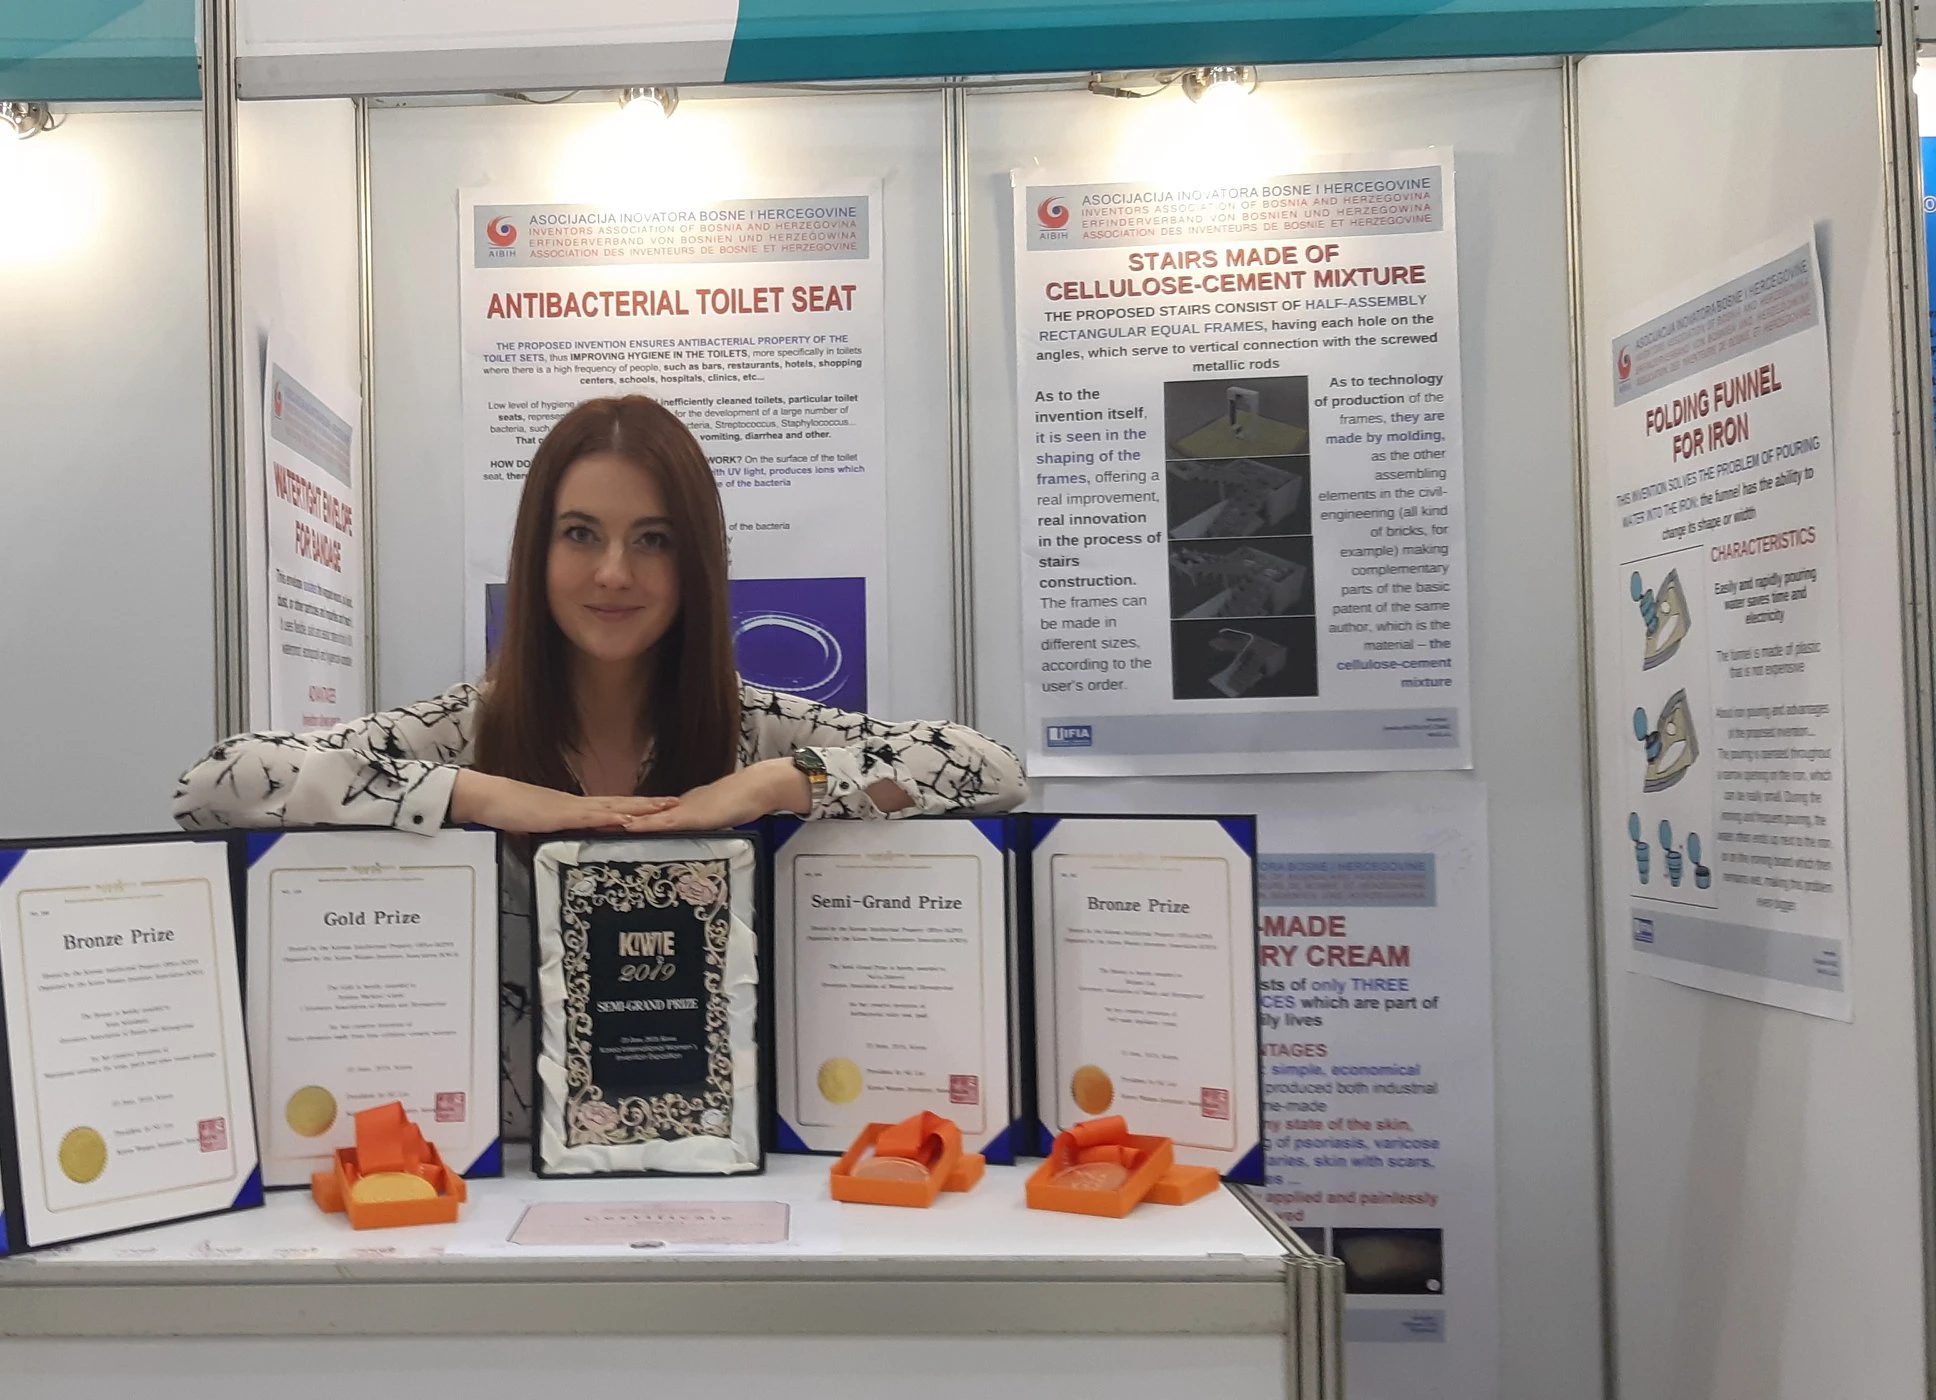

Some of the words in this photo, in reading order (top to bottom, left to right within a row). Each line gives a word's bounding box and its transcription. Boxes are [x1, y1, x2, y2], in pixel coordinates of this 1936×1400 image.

[1081, 189, 1173, 206] ASOCIJACIJA
[1177, 185, 1258, 201] INOVATORA
[1261, 183, 1311, 197] BOSNE
[1315, 183, 1319, 195] I
[1323, 177, 1430, 194] HERCEGOVINE
[529, 211, 616, 225] ASOCIJACIJA
[619, 210, 696, 223] INOVATORA
[699, 209, 745, 222] BOSNE
[749, 209, 753, 221] I
[757, 206, 856, 221] HERCEGOVINE
[1039, 232, 1068, 240] AIBIH
[488, 250, 516, 258] AIBIH
[1128, 249, 1218, 272] STAIRS
[1225, 246, 1297, 268] MADE
[1305, 244, 1339, 264] OF
[1046, 270, 1306, 302] CELLULOSE-CEMENT
[1313, 265, 1425, 289] MIXTURE
[486, 288, 689, 319] ANTIBACTERIAL
[696, 288, 784, 316] TOILET
[792, 285, 857, 312] SEAT
[1044, 309, 1072, 323] THE
[1075, 306, 1155, 322] PROPOSED
[1159, 303, 1211, 318] STAIRS
[1214, 301, 1275, 316] CONSIST
[1281, 300, 1301, 313] OF
[1305, 294, 1425, 312] HALF-ASSEMBLY
[1038, 324, 1146, 342] RECTANGULAR
[1150, 322, 1199, 337] EQUAL
[1203, 319, 1267, 336] FRAMES,
[1271, 317, 1317, 334] having
[1320, 315, 1353, 329] each
[1357, 314, 1386, 328] hole
[1390, 315, 1408, 326] on
[1411, 312, 1434, 325] the
[496, 341, 515, 351] THE
[517, 339, 572, 350] PROPOSED
[574, 338, 626, 349] INVENTION
[629, 337, 675, 348] ENSURES
[677, 335, 755, 347] ANTIBACTERIAL
[757, 334, 810, 345] PROPERTY
[812, 334, 826, 344] OF
[829, 333, 848, 343] THE
[1036, 346, 1084, 364] angles,
[1087, 344, 1128, 359] which
[1131, 345, 1168, 357] serve
[1172, 342, 1186, 355] to
[1189, 339, 1239, 354] vertical
[1242, 336, 1319, 352] connection
[1322, 335, 1351, 348] with
[1354, 333, 1376, 347] the
[1380, 331, 1438, 346] screwed
[483, 353, 516, 363] TOILET
[519, 352, 545, 363] SETS,
[548, 351, 568, 361] thus
[569, 350, 625, 361] IMPROVING
[627, 349, 671, 360] HYGIENE
[672, 349, 683, 359] IN
[685, 348, 705, 358] THE
[707, 347, 750, 359] TOILETS,
[752, 349, 775, 357] more
[776, 346, 824, 359] specifically
[825, 345, 834, 355] in
[836, 345, 862, 355] toilets
[1192, 358, 1245, 373] metallic
[1248, 357, 1280, 371] rods
[579, 374, 616, 386] centers,
[618, 374, 658, 385] schools,
[660, 373, 705, 385] hospitals,
[707, 372, 740, 383] clinics,
[1329, 376, 1347, 388] As
[1350, 376, 1364, 387] to
[1367, 374, 1443, 390] technology
[660, 395, 714, 408] inefficiently
[715, 394, 752, 405] cleaned
[787, 393, 832, 405] particular
[834, 392, 858, 402] toilet
[1034, 390, 1054, 402] As
[1058, 389, 1073, 401] to
[1076, 388, 1100, 401] the
[1314, 395, 1328, 407] of
[1331, 393, 1405, 409] production
[1408, 393, 1420, 404] of
[1423, 392, 1444, 404] the
[1646, 389, 1709, 436] FOLDING
[1714, 362, 1782, 412] FUNNEL
[1034, 409, 1103, 423] invention
[1107, 408, 1147, 422] itself,
[699, 430, 742, 443] vomiting,
[744, 429, 783, 440] diarrhea
[785, 429, 803, 439] and
[804, 428, 831, 438] other.
[1035, 432, 1045, 444] it
[1048, 432, 1062, 443] is
[1065, 433, 1101, 443] seen
[1105, 430, 1119, 442] in
[1123, 429, 1146, 441] the
[1324, 432, 1362, 445] made
[1365, 432, 1382, 446] by
[1386, 430, 1445, 446] molding,
[1672, 428, 1704, 463] FOR
[1708, 412, 1749, 452] IRON
[1036, 451, 1094, 467] shaping
[1098, 450, 1113, 462] of
[1117, 449, 1141, 462] the
[1716, 454, 1760, 476] PROBLEM
[1762, 448, 1774, 464] OF
[1776, 436, 1820, 460] POURING
[1036, 472, 1090, 486] frames,
[1094, 470, 1147, 486] offering
[1150, 472, 1159, 482] a
[1373, 468, 1447, 483] assembling
[1037, 514, 1064, 526] real
[1069, 512, 1147, 525] innovation
[1038, 535, 1052, 547] in
[1055, 535, 1079, 547] the
[1083, 535, 1142, 549] process
[1146, 533, 1161, 544] of
[1711, 526, 1816, 562] CHARACTERISTICS
[1038, 555, 1080, 567] stairs
[1350, 563, 1449, 579] complementary
[1038, 574, 1136, 588] construction.
[1335, 657, 1452, 670] cellulose-cement
[1400, 675, 1452, 687] mixture
[811, 894, 911, 910] Semi-Grand
[918, 896, 962, 910] Prize
[1088, 896, 1141, 912] Bronze
[1148, 898, 1190, 914] Prize
[324, 910, 366, 926] Gold
[374, 910, 421, 925] Prize
[63, 931, 124, 952] Bronze
[131, 927, 175, 946] Prize
[1306, 945, 1410, 967] CREAM
[618, 956, 676, 982] 2019
[1289, 978, 1307, 991] of
[1309, 978, 1346, 995] only
[1351, 978, 1409, 991] THREE
[596, 999, 665, 1013] SEMI-GRAND
[666, 998, 699, 1010] PRIZE
[1300, 996, 1350, 1009] which
[1353, 999, 1380, 1009] are
[1383, 996, 1417, 1013] part
[1421, 996, 1439, 1009] of
[1283, 1013, 1323, 1027] lives
